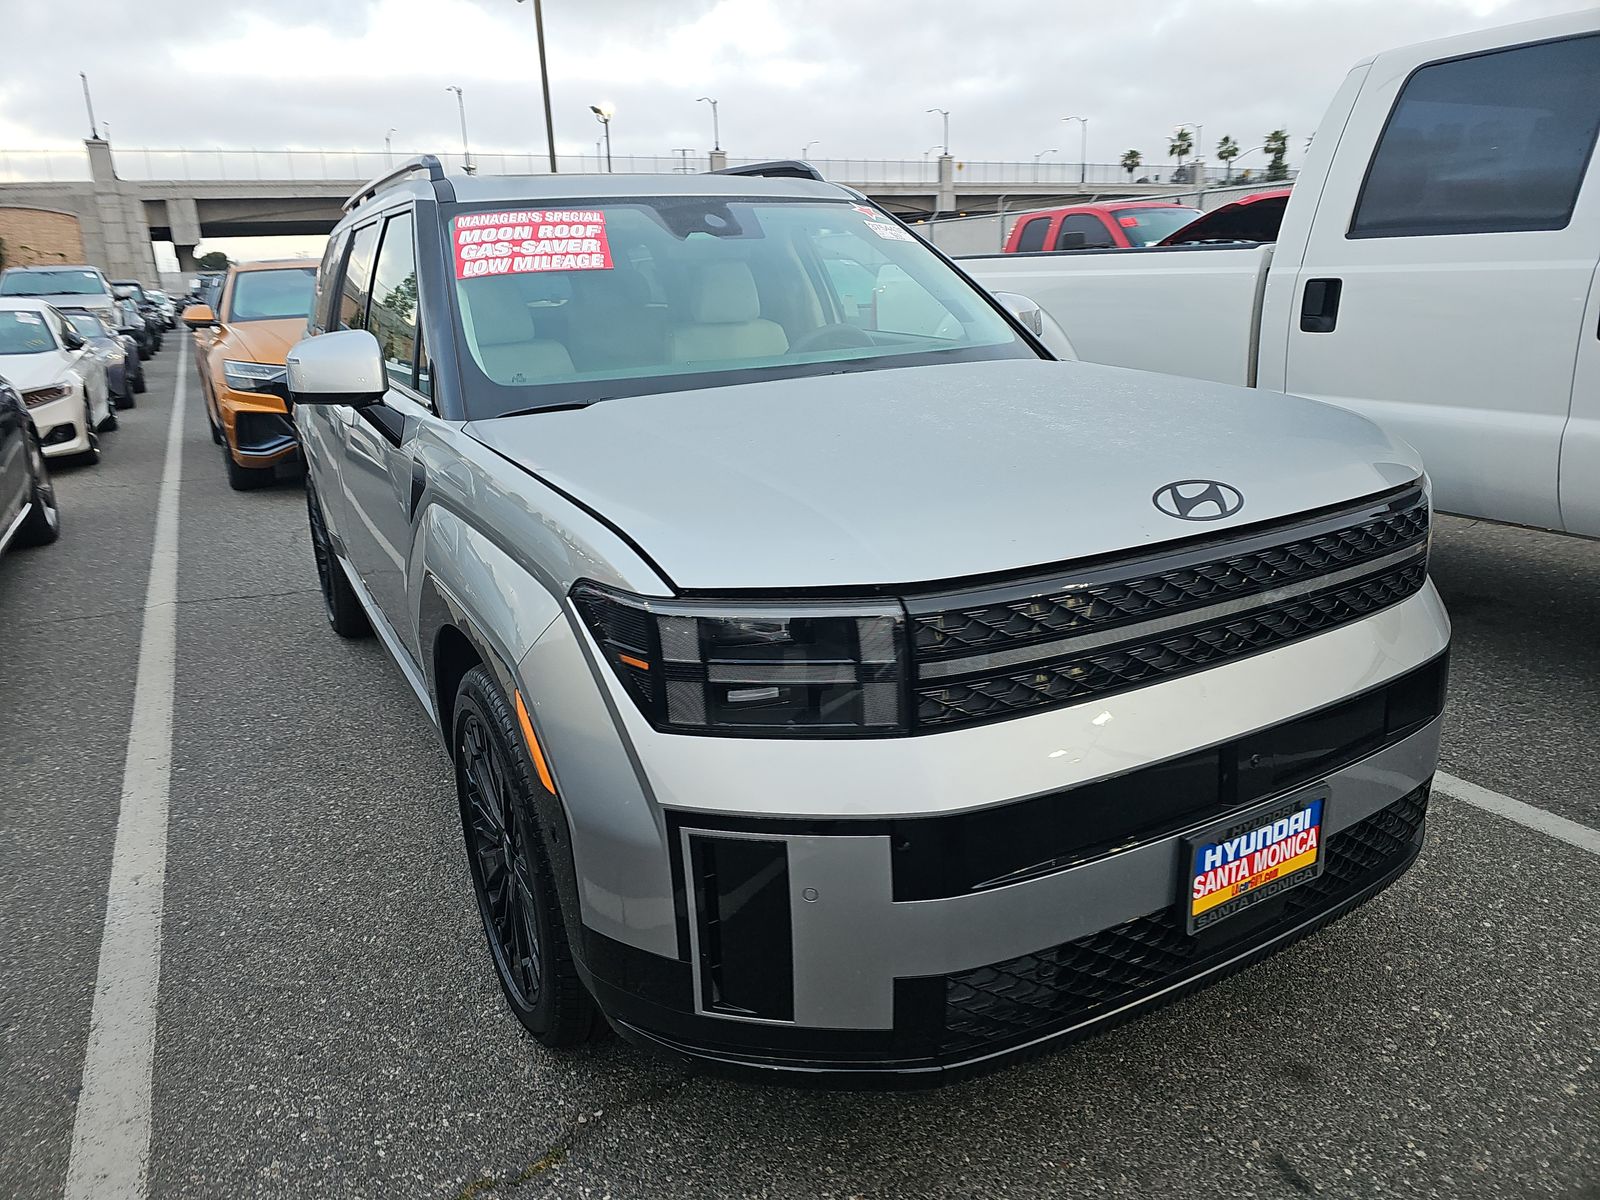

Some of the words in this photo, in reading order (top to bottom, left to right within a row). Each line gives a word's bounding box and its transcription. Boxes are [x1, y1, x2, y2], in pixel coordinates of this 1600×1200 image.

[457, 212, 543, 228] MANAGER'S
[545, 211, 604, 223] SPECIAL
[458, 225, 533, 245] MOON
[537, 224, 602, 240] ROOF
[460, 239, 602, 260] GAS-SAVER
[462, 257, 513, 277] LOW
[512, 254, 605, 272] MILEAGE
[1204, 808, 1312, 872] HYUNDAI
[1192, 860, 1250, 899] SANTA
[1253, 828, 1318, 874] MONICA
[1197, 896, 1249, 928] SANTA
[1253, 868, 1314, 902] MONICA
